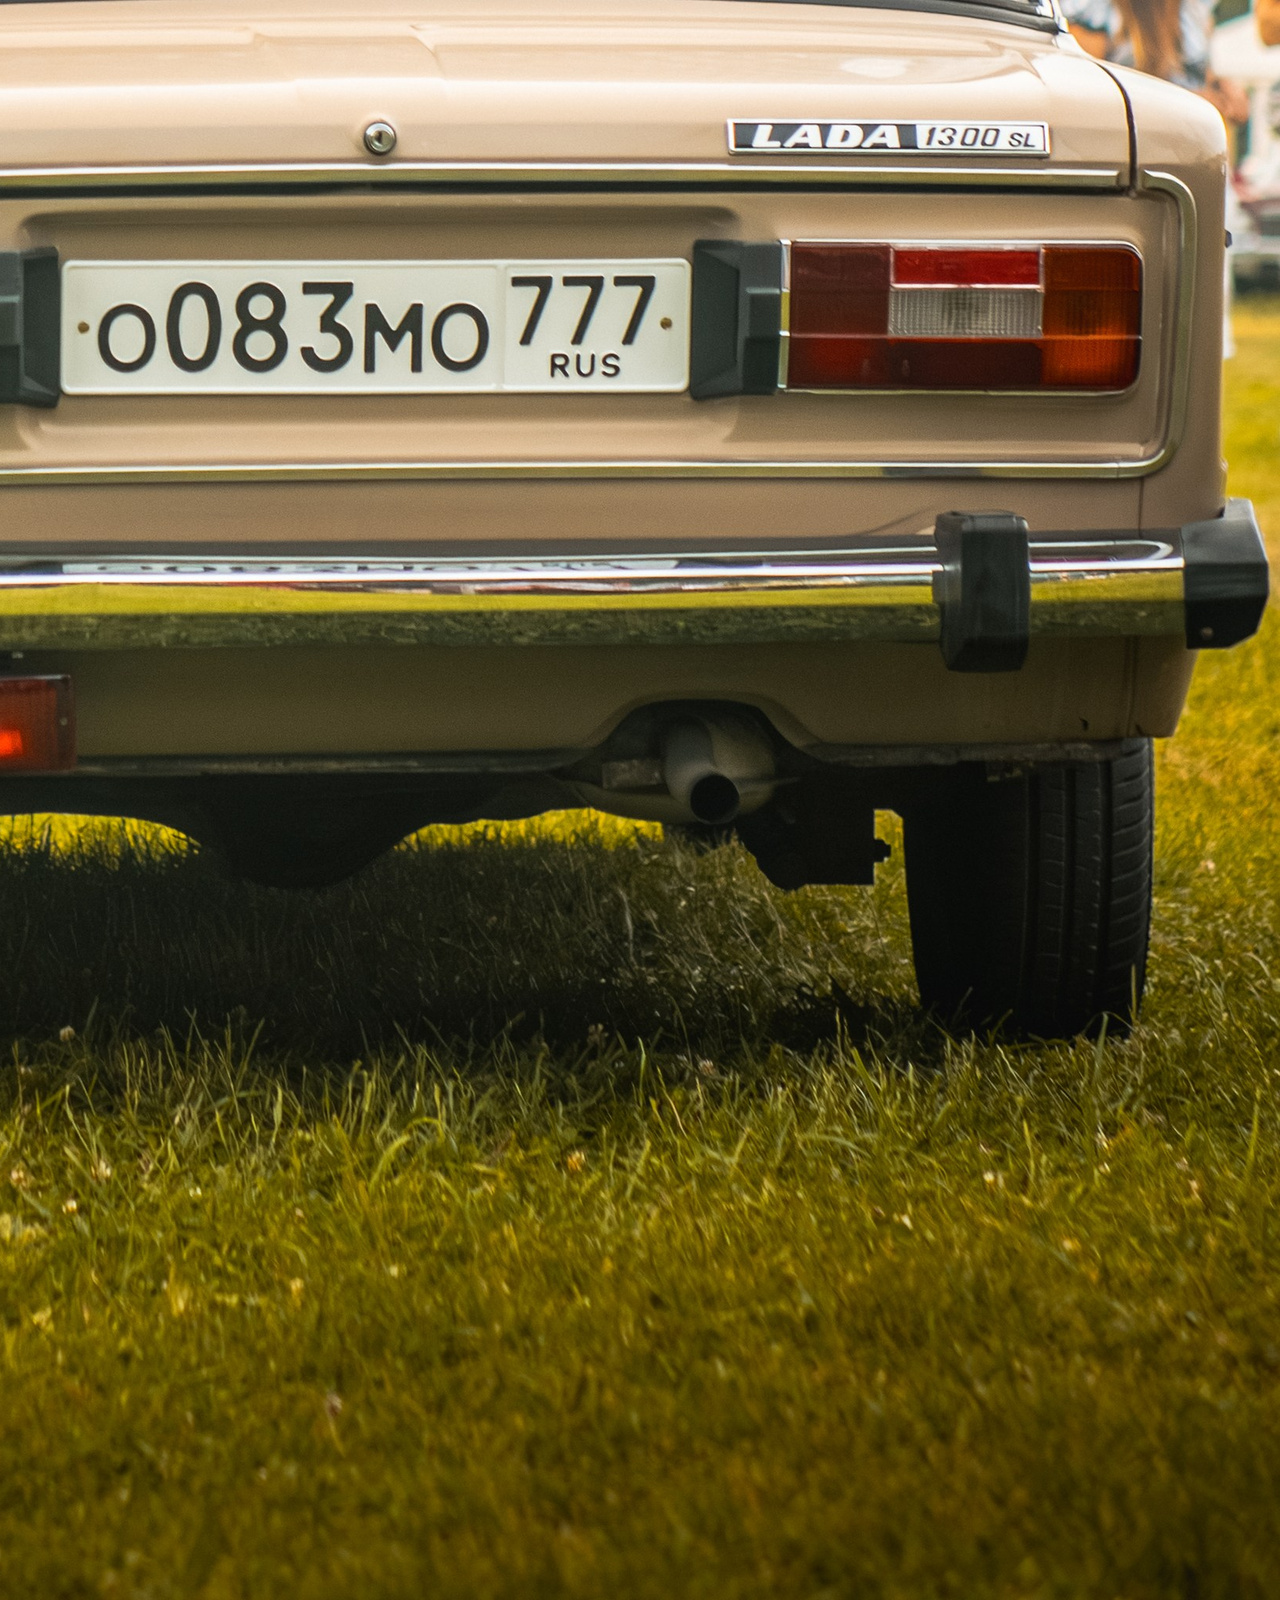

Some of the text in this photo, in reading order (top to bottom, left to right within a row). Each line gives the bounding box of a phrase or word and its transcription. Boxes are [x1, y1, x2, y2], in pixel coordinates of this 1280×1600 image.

[752, 124, 1037, 148] LADA 1300 SL
[97, 275, 657, 373] O083MO 777
[549, 352, 622, 379] RUS
